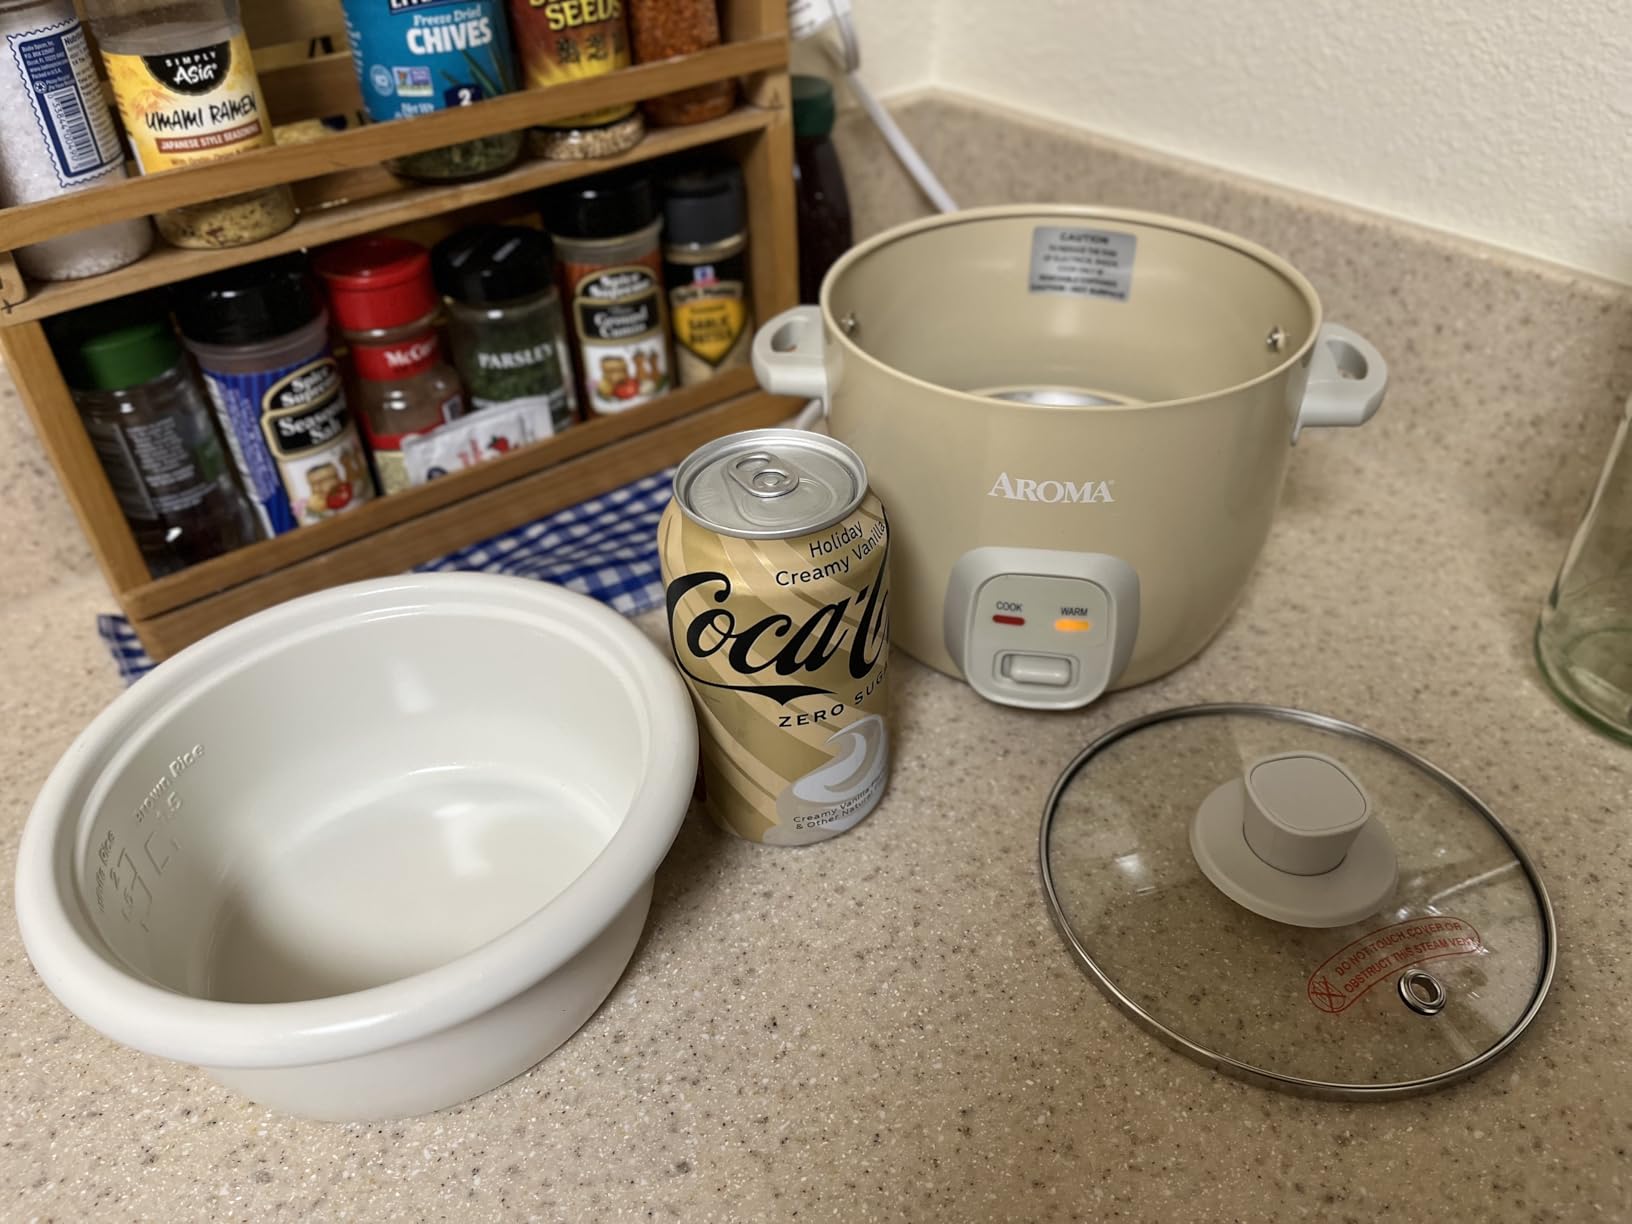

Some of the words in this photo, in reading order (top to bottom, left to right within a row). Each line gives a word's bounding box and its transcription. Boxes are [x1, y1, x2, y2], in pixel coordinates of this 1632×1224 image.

[413, 12, 452, 26] Freeze
[454, 5, 481, 21] Dried
[545, 0, 620, 30] SEEDS
[406, 17, 492, 55] CHIVES
[165, 52, 217, 67] SIMPLY
[173, 63, 215, 84] Asia
[145, 108, 204, 132] UMAMI
[209, 91, 257, 124] RAMEN
[161, 136, 199, 150] JAPANESE
[200, 133, 223, 147] STYLE
[593, 304, 648, 327] Ground
[478, 342, 552, 369] PARSLEY
[987, 471, 1115, 504] AROMA
[809, 521, 864, 558] Holiday
[775, 556, 849, 586] Creamy
[852, 520, 886, 561] Vanilla
[996, 601, 1023, 612] COOK
[1060, 607, 1088, 616] WARM
[779, 704, 844, 728] ZERO
[168, 744, 204, 778] Rice
[793, 807, 837, 823] Creamy
[807, 814, 839, 828] Other
[1335, 962, 1352, 977] DO
[1351, 947, 1371, 965] NOT
[1370, 931, 1408, 953] TOUCH
[1407, 924, 1444, 938] COVER
[1445, 921, 1462, 932] OR
[1343, 957, 1392, 994] OBSTRUCT
[1393, 946, 1416, 962] THIS
[1416, 938, 1448, 955] STEAM
